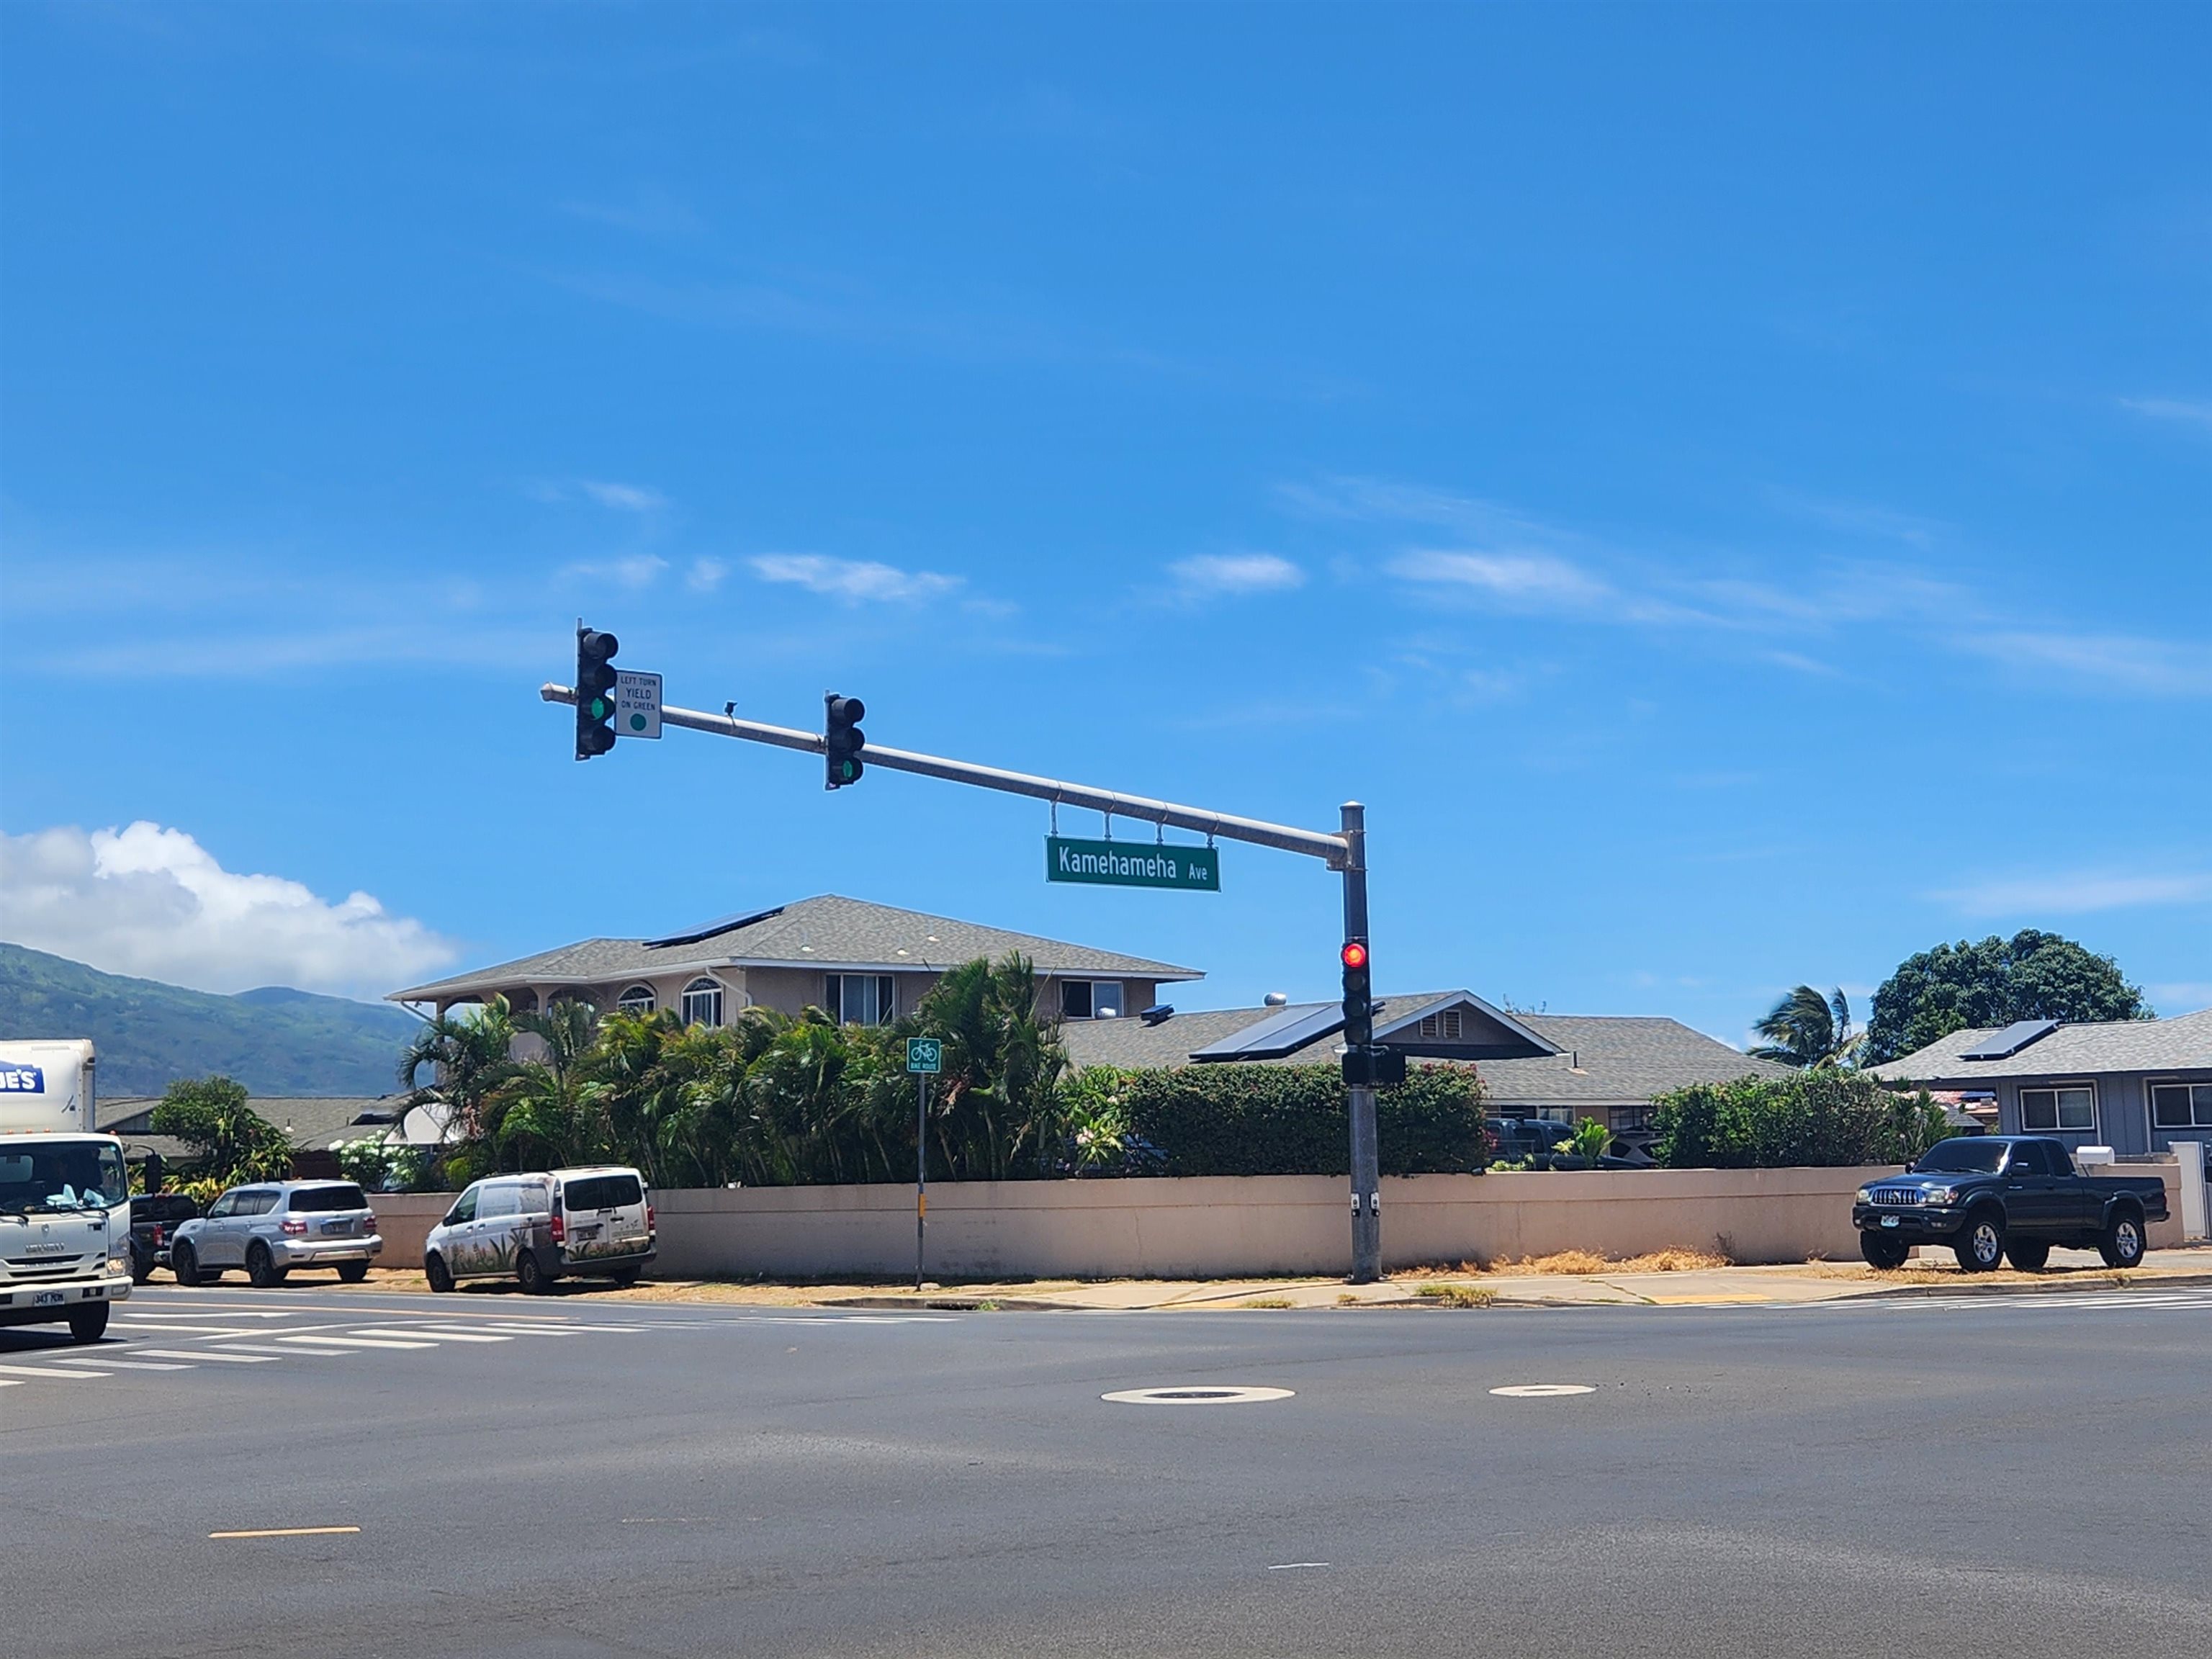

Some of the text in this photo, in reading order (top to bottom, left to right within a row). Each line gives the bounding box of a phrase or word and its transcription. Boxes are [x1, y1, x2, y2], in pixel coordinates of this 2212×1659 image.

[621, 676, 657, 686] LEFT TURN
[626, 687, 652, 700] YIELD
[621, 700, 655, 711] ON GREEN
[1058, 846, 1208, 881] Kamehameha Ave
